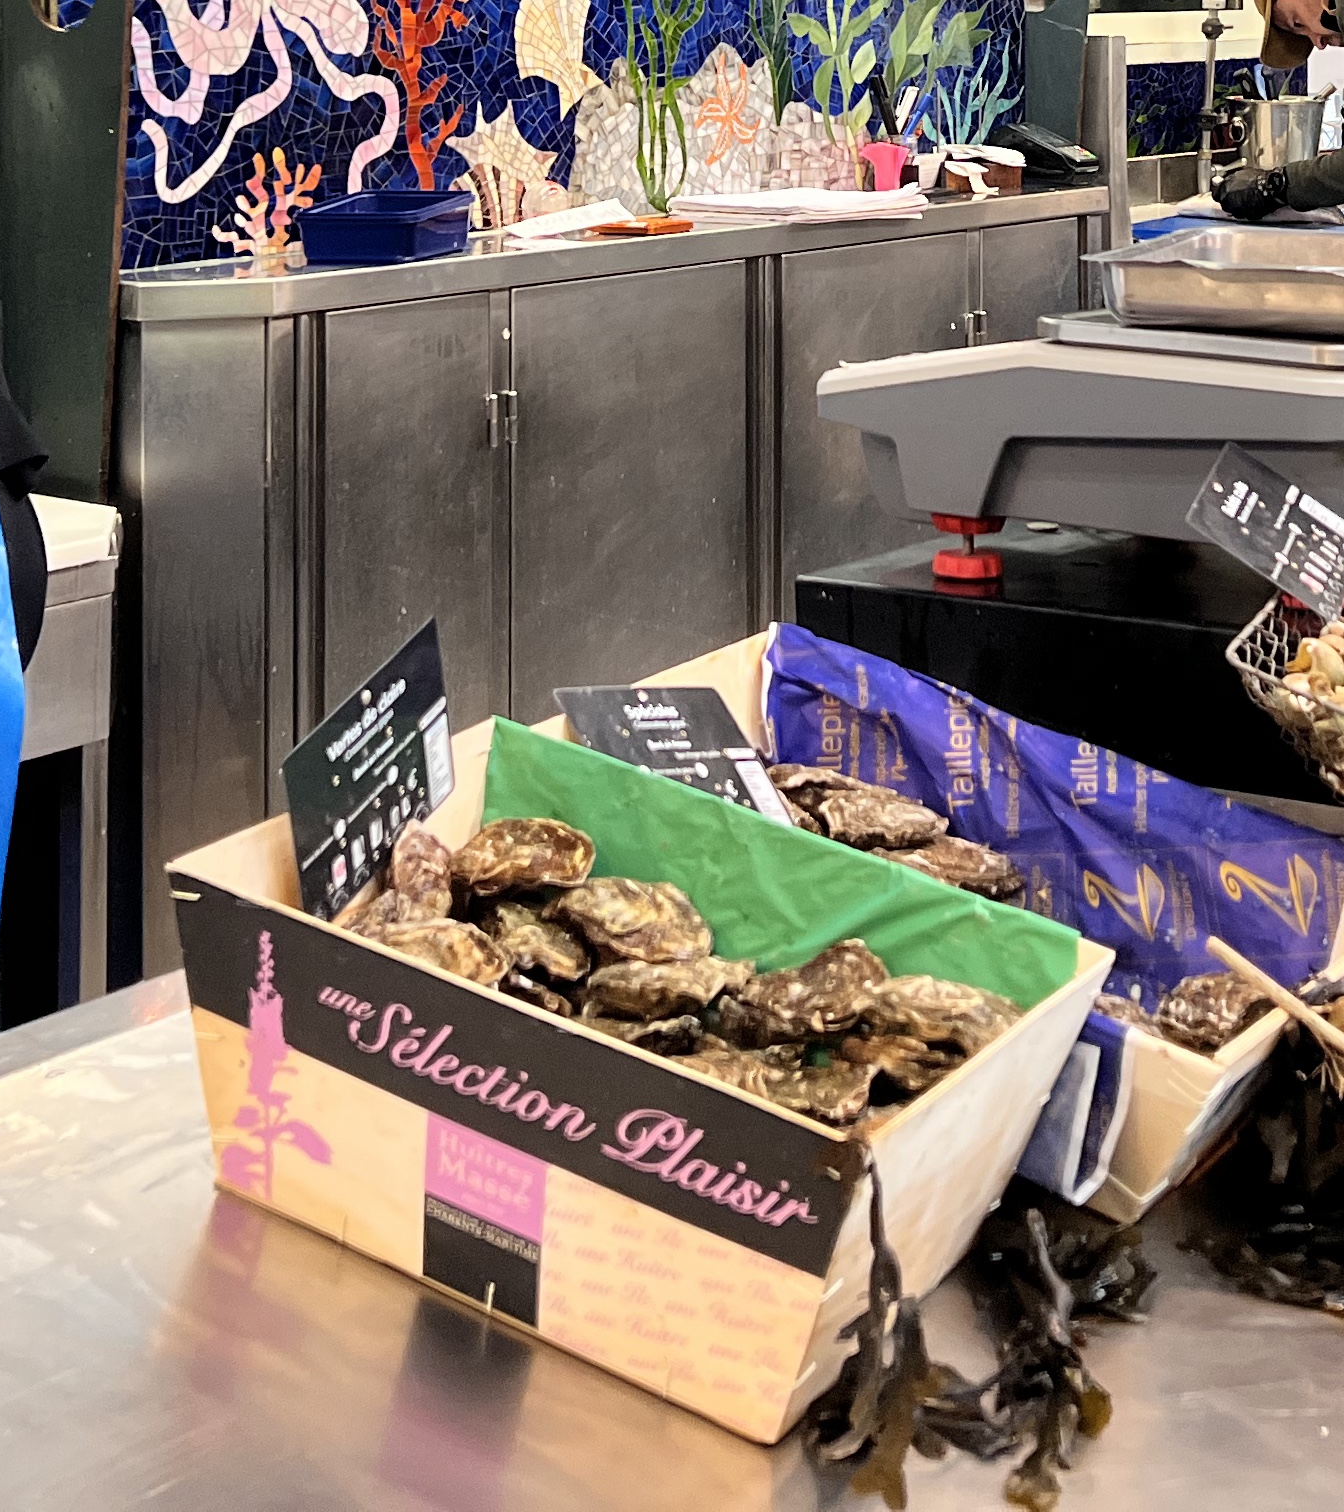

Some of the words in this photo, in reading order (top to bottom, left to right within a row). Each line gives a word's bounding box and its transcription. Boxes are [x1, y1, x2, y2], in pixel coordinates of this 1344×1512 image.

[317, 985, 377, 1021] une
[347, 1002, 597, 1143] Sélection
[600, 1108, 819, 1228] Plaisir
